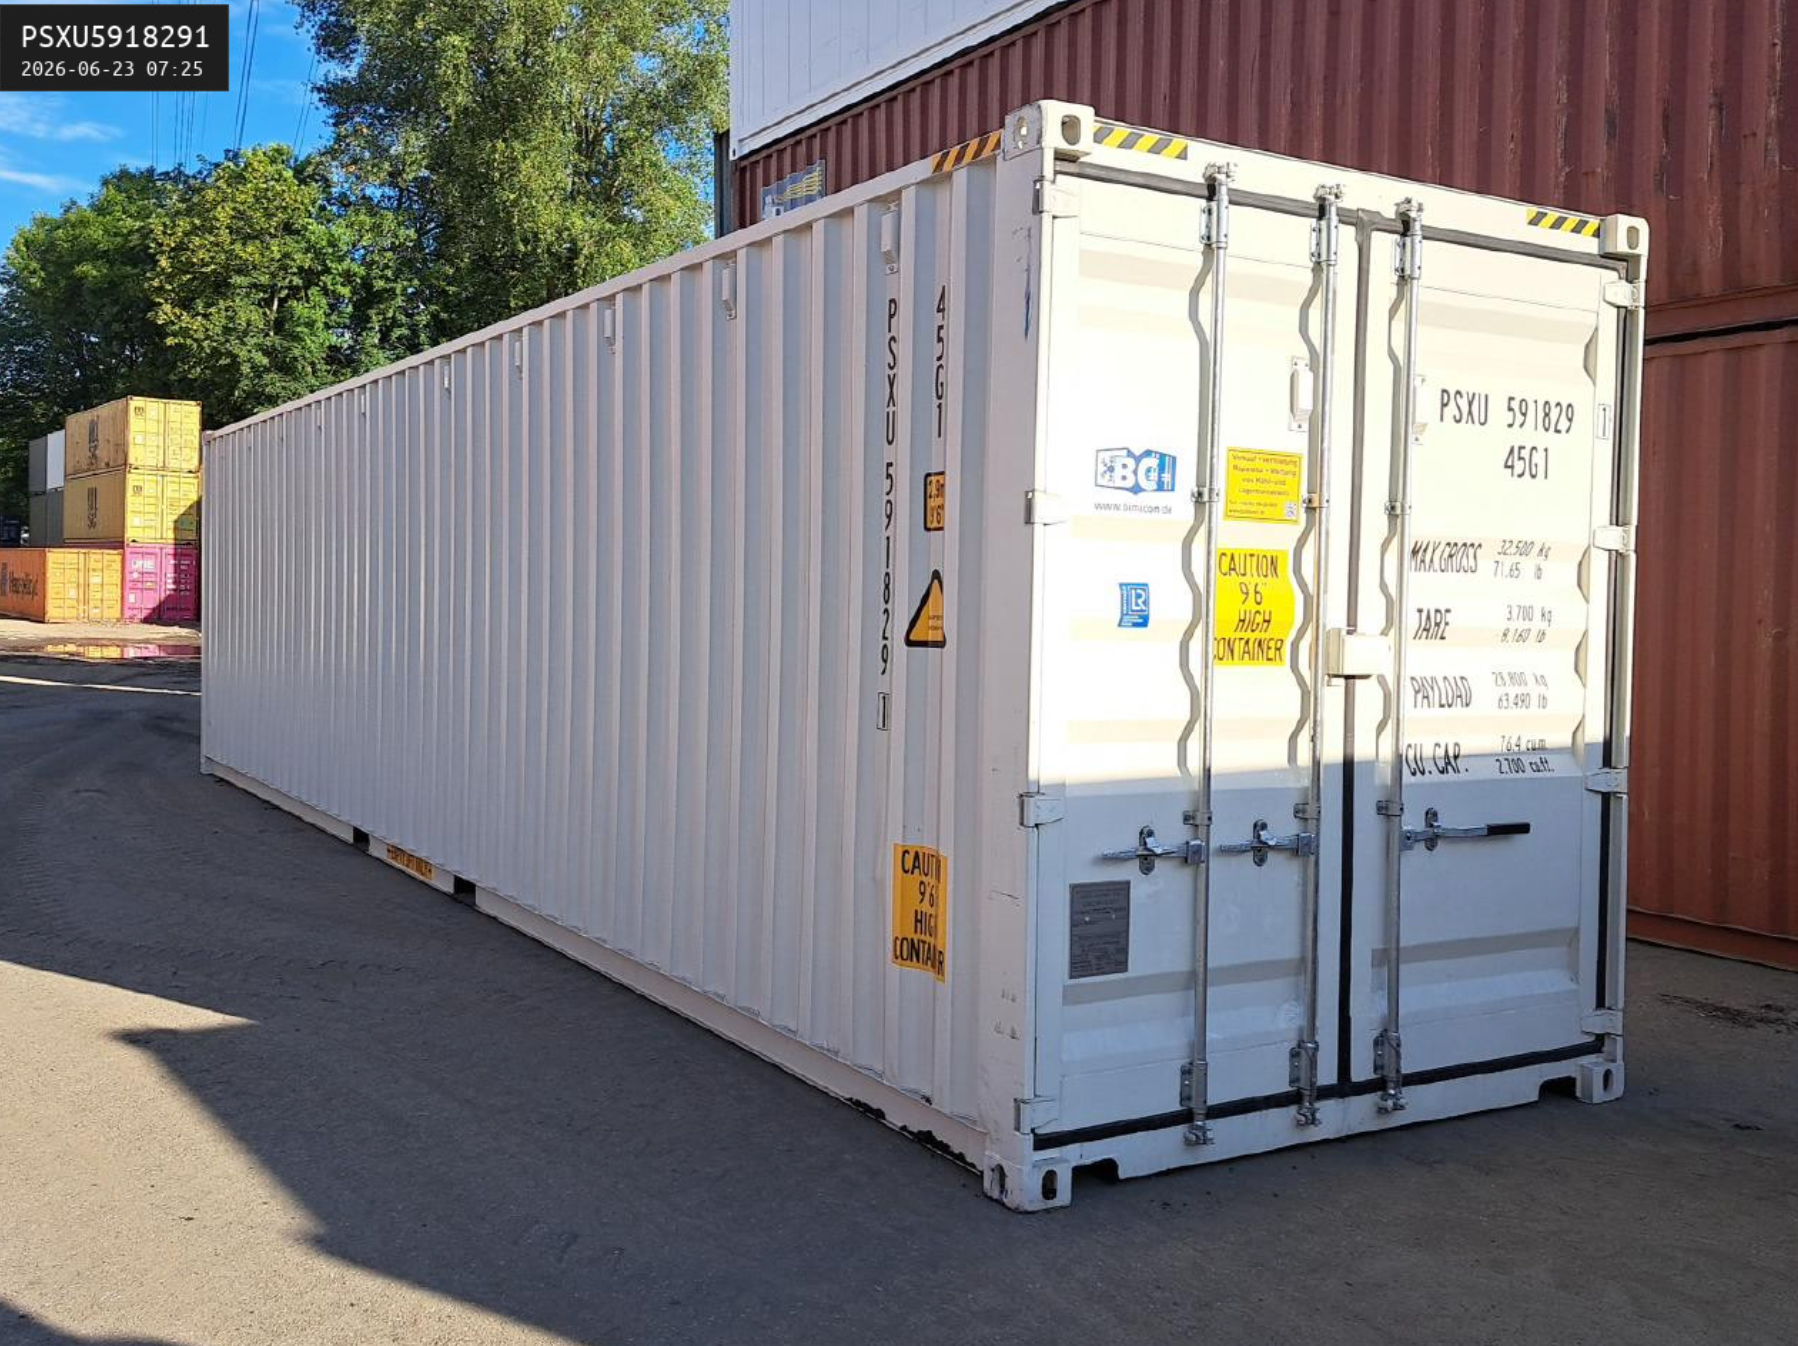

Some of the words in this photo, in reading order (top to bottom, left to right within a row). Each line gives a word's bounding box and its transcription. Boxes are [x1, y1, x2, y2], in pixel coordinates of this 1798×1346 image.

[886, 298, 898, 446] PSXU
[935, 285, 946, 438] 45G1
[1440, 388, 1489, 426] PSXU
[1507, 396, 1575, 434] 591829
[1504, 445, 1549, 480] 45G1
[880, 462, 895, 676] 591829
[1219, 552, 1279, 578] CAUTION
[1234, 609, 1273, 633] HIGH
[1413, 608, 1451, 640] TARE
[1507, 604, 1534, 622] 3.700
[1541, 606, 1552, 627] kg
[1214, 637, 1284, 662] ONTAINER
[1410, 675, 1472, 709] PAYLOAD
